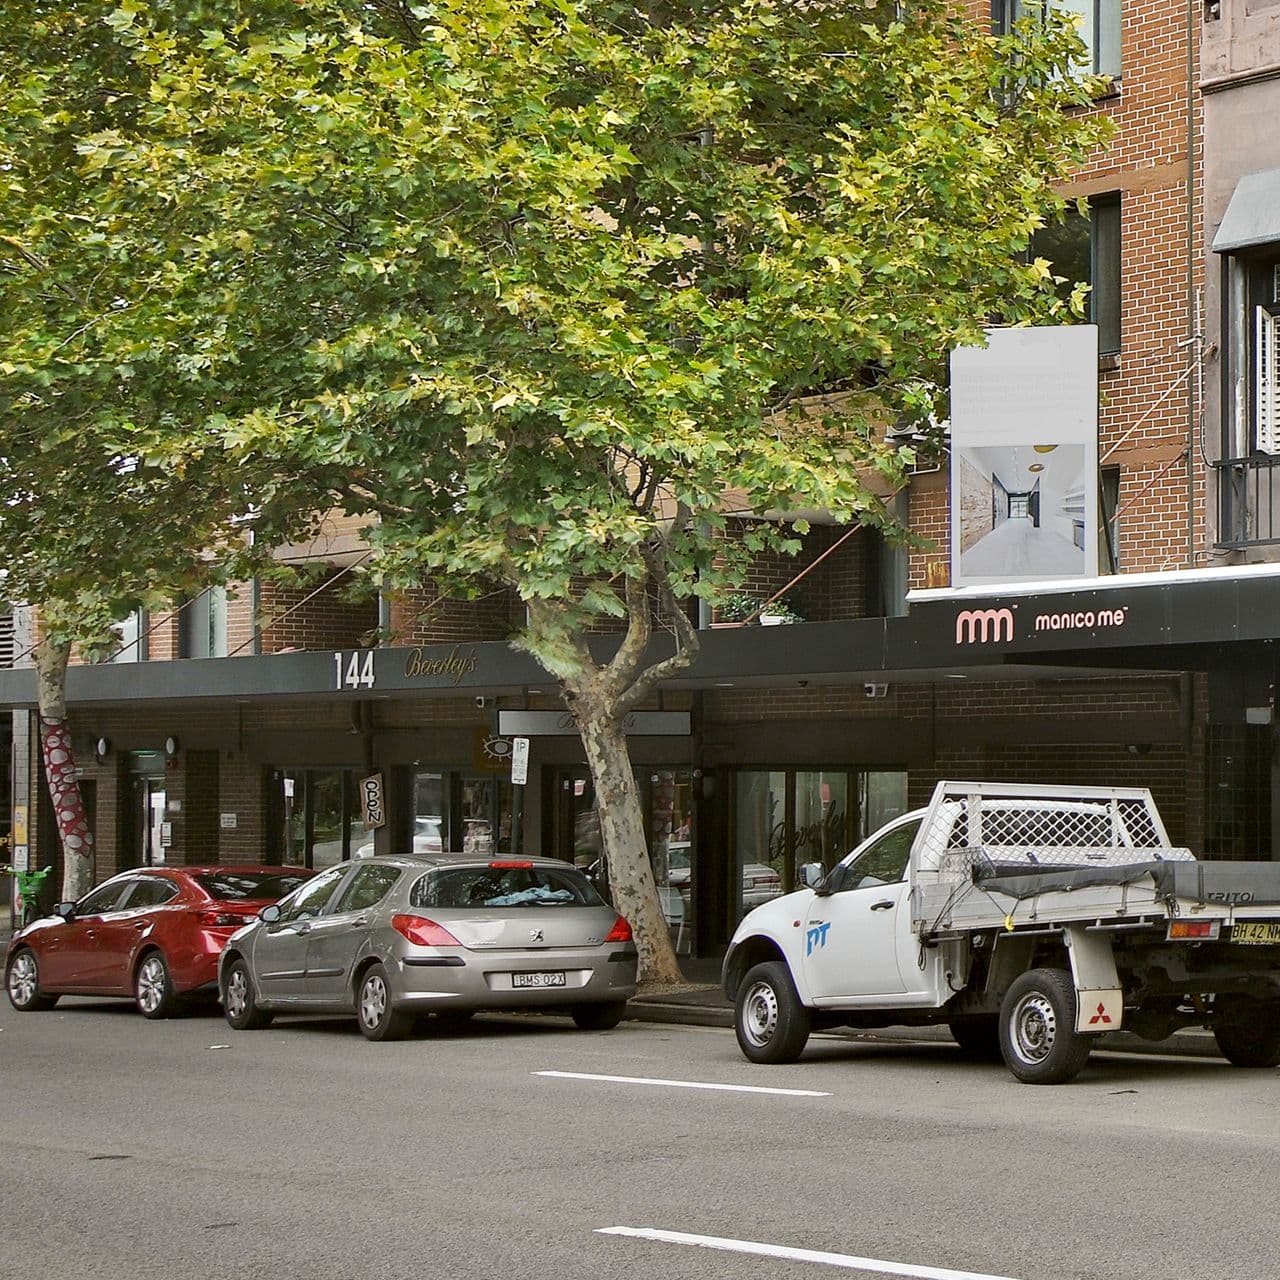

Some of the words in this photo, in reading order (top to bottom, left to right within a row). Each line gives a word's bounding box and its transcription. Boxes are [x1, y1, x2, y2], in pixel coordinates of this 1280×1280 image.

[1035, 611, 1095, 631] manico
[1097, 609, 1124, 627] me
[334, 650, 375, 689] 144
[404, 645, 477, 687] Beverley's
[1250, 924, 1265, 938] 42
